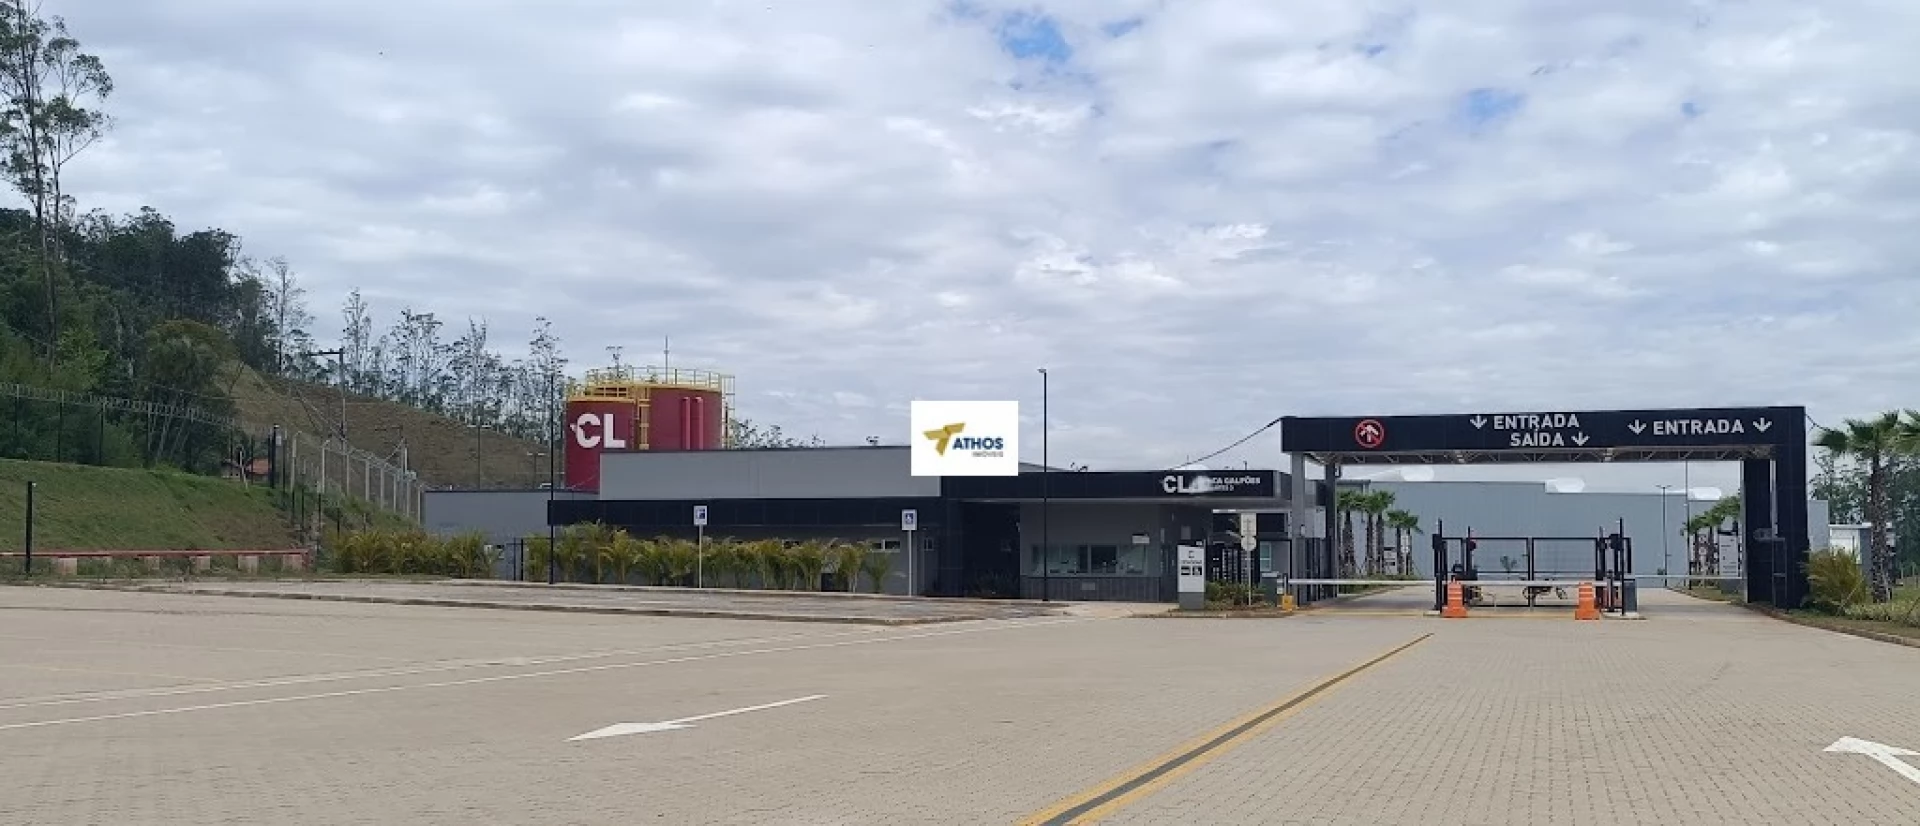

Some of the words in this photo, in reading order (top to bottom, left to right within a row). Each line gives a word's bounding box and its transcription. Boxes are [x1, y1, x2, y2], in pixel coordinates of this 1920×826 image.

[1493, 413, 1580, 430] ENTRADA
[1653, 419, 1745, 436] ENTRADA
[576, 413, 626, 449] CL
[1510, 428, 1565, 447] SAÍDA
